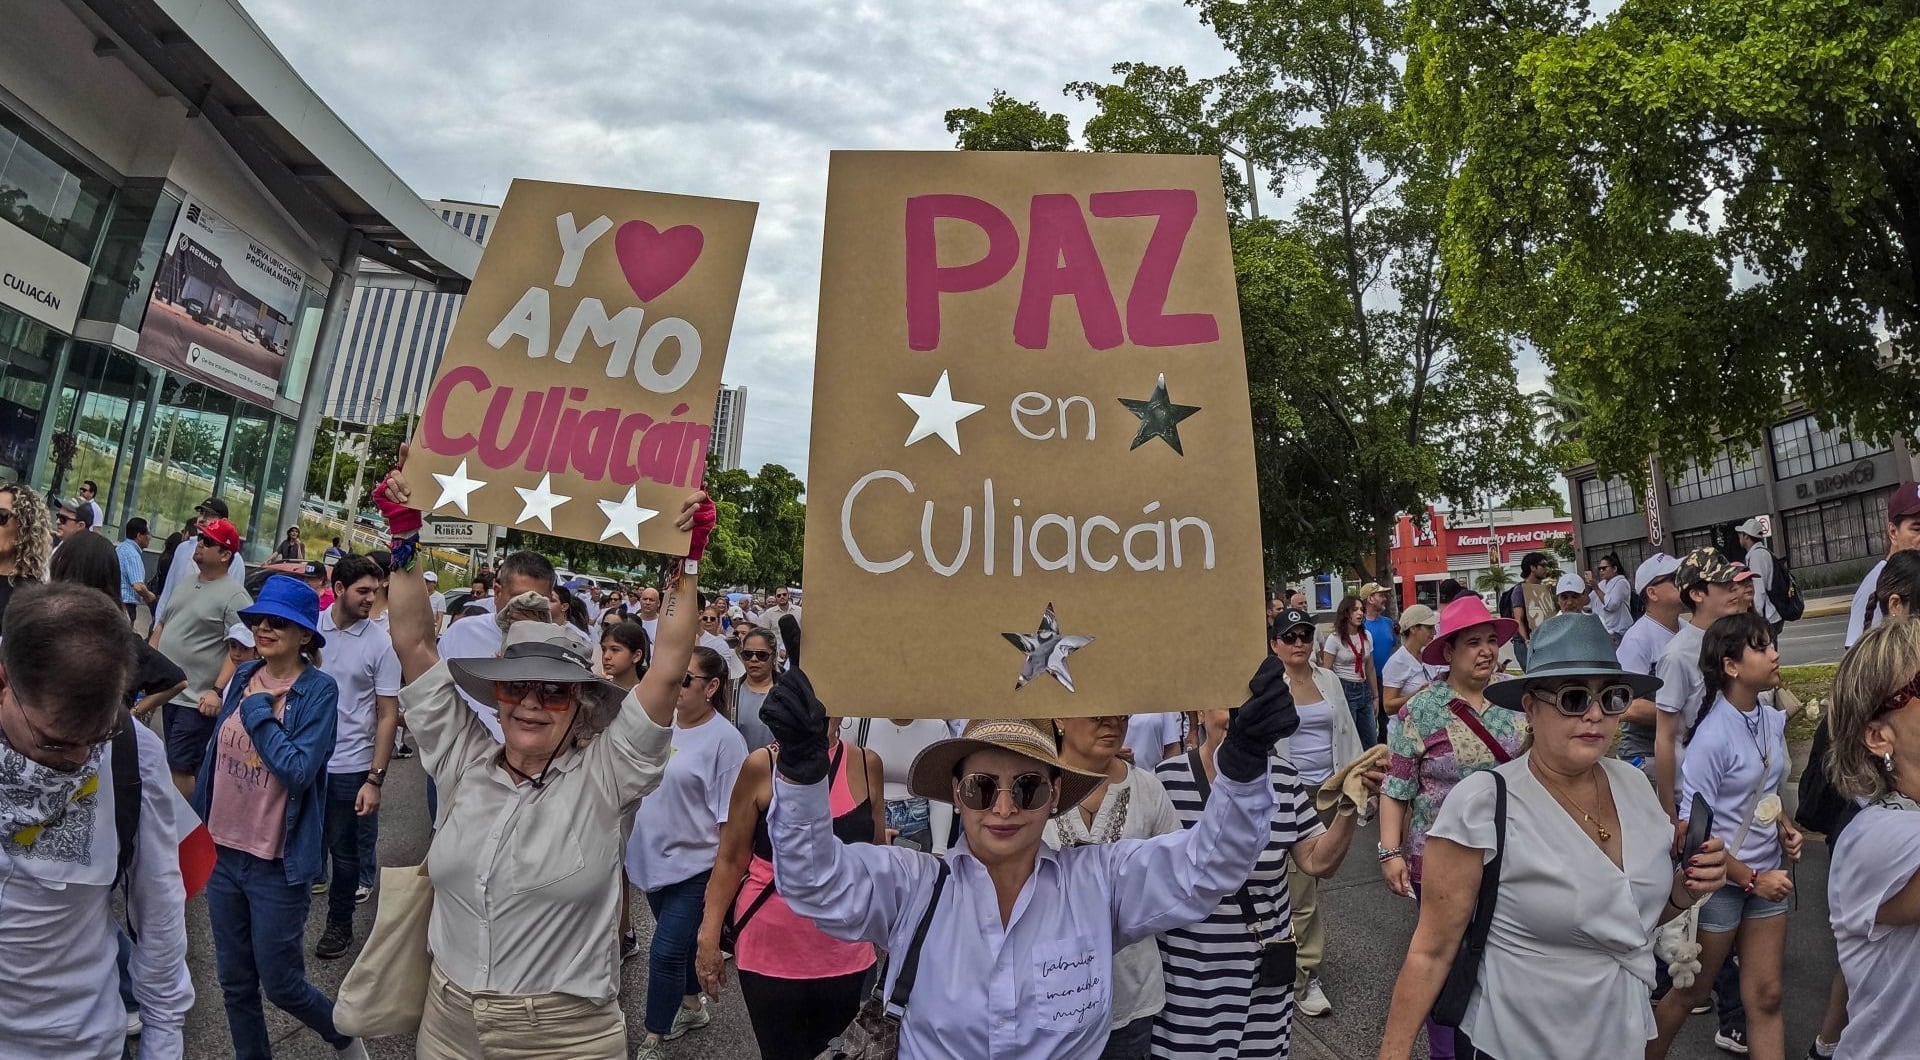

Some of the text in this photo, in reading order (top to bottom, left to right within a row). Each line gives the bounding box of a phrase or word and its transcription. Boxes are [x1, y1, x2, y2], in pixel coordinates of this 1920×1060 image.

[188, 245, 218, 269] RENAULT
[245, 252, 299, 292] PRÓXIMAMENTE
[248, 242, 302, 283] NUEVA UBICACIÓN
[553, 211, 614, 288] Y
[905, 189, 1219, 351] PAZ
[3, 272, 61, 311] CULIACÁN
[486, 286, 702, 394] AMO
[421, 365, 711, 489] Culiacán
[1010, 391, 1096, 440] en
[841, 469, 1216, 577] Culiacán
[1646, 477, 1660, 540] BRONCO
[1457, 534, 1506, 547] Kentuky
[1507, 531, 1532, 543] Fried
